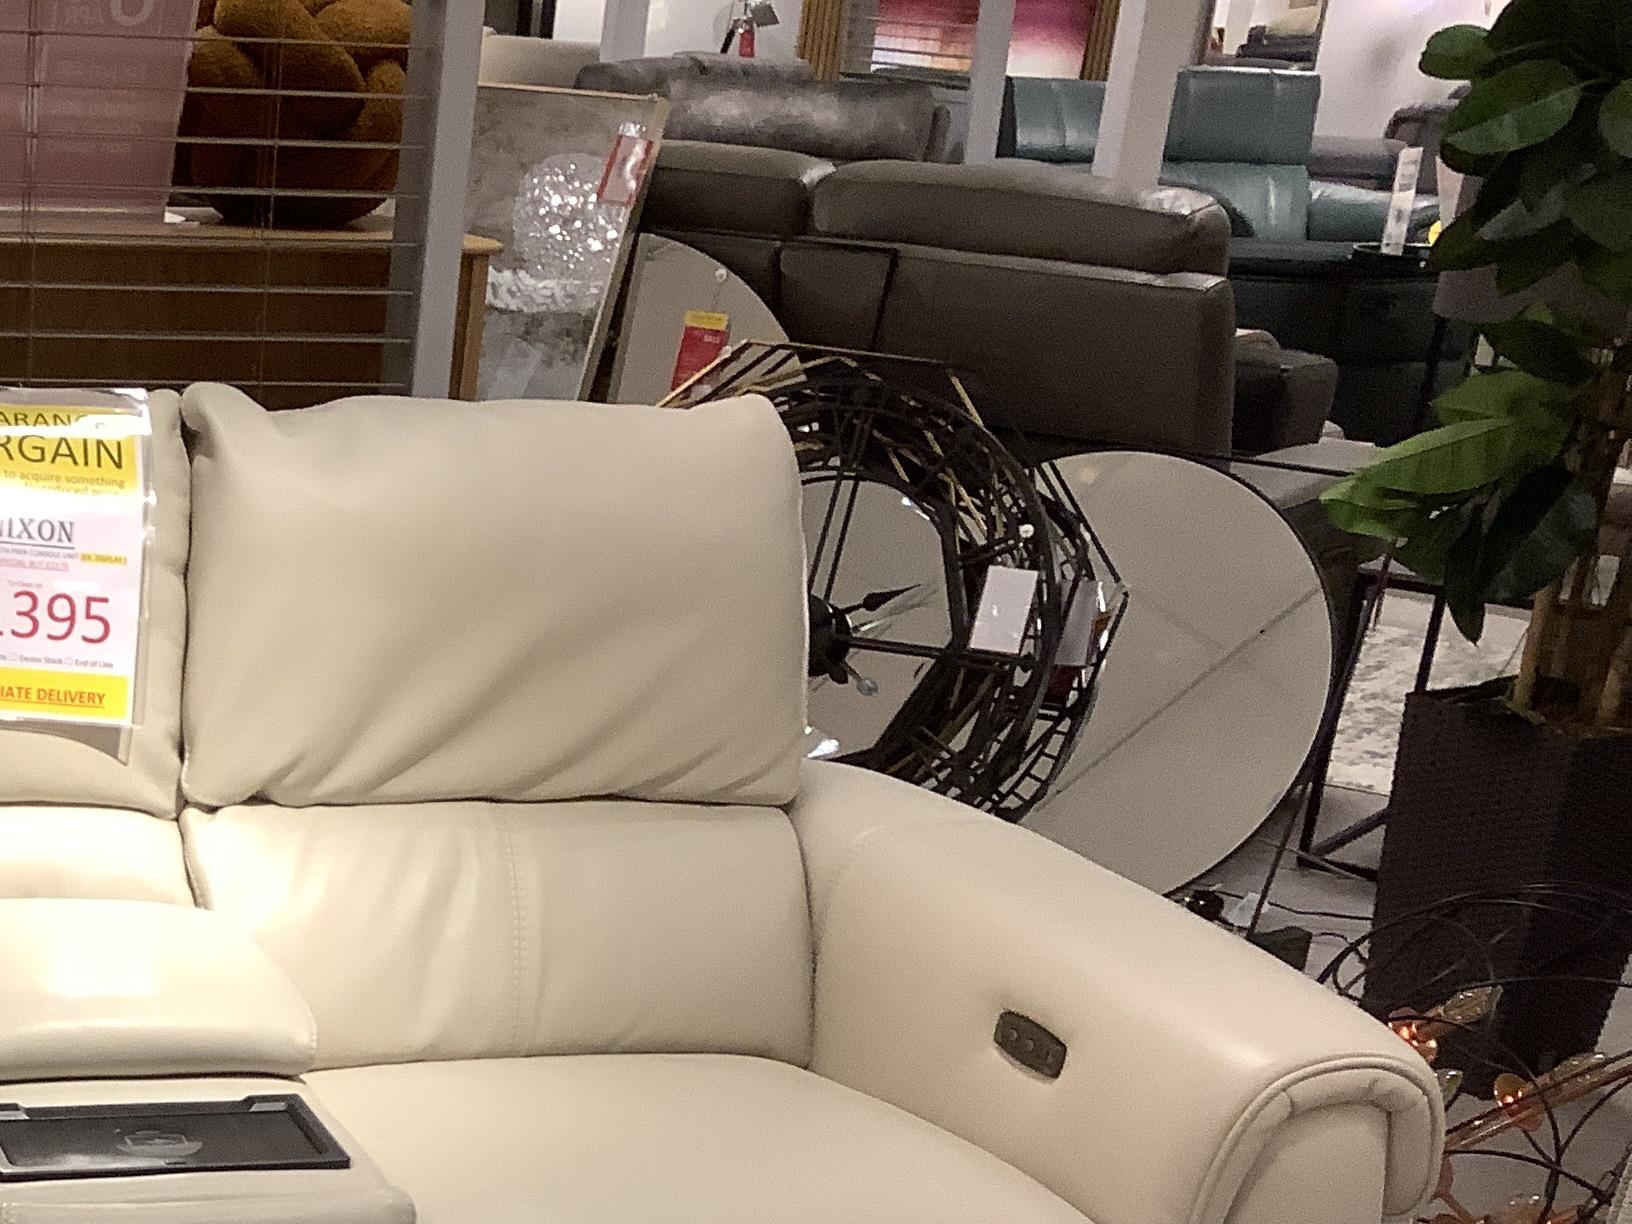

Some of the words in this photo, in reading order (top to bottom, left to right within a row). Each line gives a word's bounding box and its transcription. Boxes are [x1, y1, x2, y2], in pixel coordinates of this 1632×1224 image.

[4, 469, 17, 479] to
[19, 472, 62, 484] acquire
[64, 474, 126, 489] something
[37, 688, 106, 706] DELIVERY
